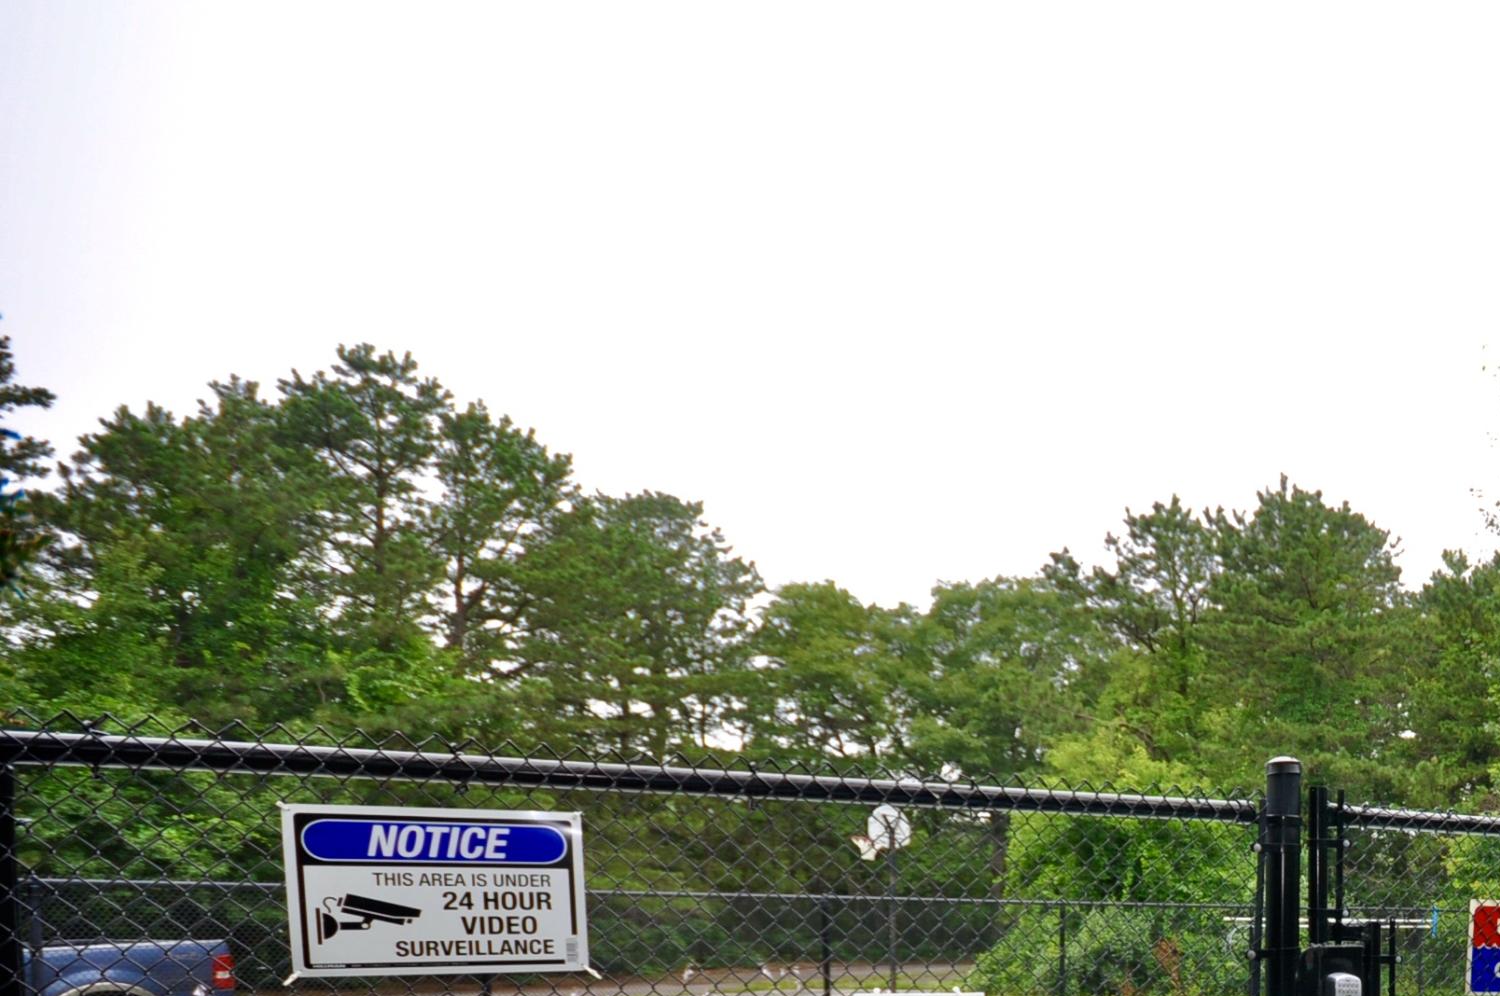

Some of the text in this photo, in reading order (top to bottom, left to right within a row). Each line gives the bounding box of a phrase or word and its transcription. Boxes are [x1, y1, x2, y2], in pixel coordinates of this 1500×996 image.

[367, 824, 511, 860] NOTICE
[372, 872, 551, 887] THIS AREA IS UNDER
[442, 891, 552, 911] 24 HOUR
[461, 916, 538, 935] VIDEO
[395, 939, 555, 958] SURVEILLANCE
